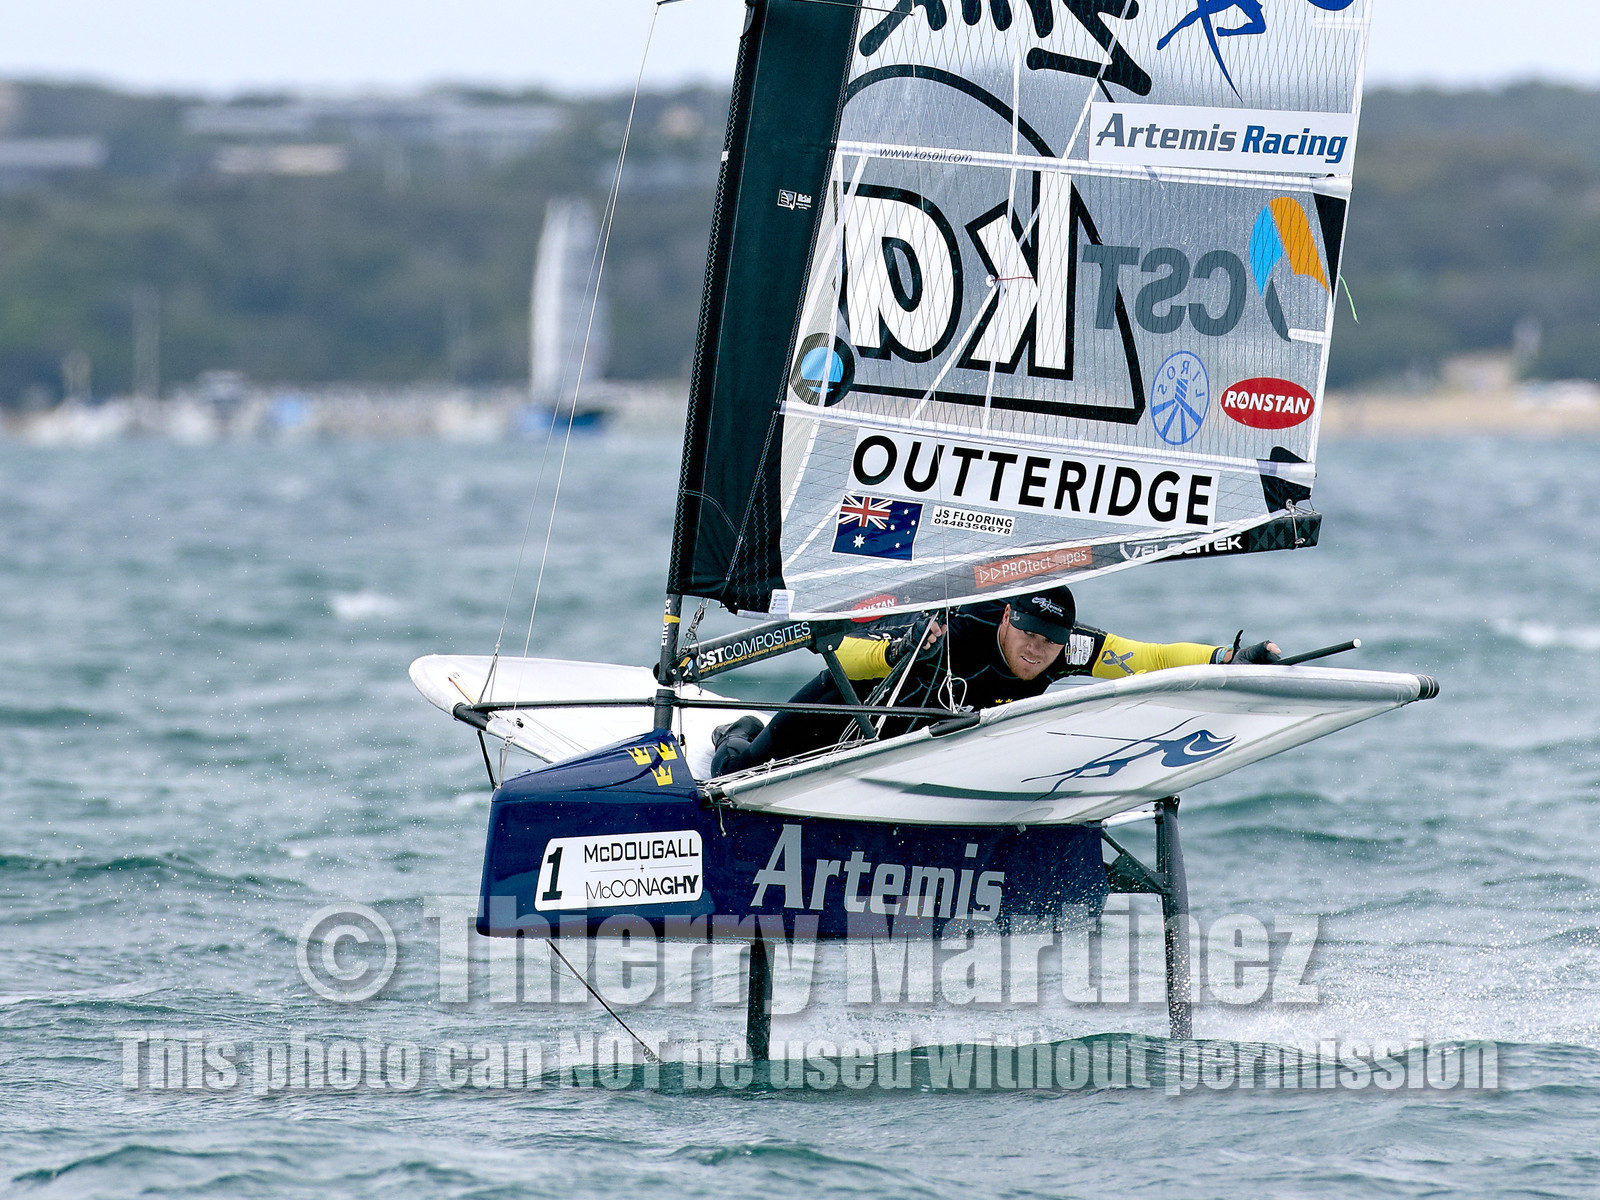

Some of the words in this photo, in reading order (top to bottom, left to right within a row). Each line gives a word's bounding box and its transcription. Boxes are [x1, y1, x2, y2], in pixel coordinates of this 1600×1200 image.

[1096, 112, 1237, 152] Artemis
[1241, 125, 1348, 164] Racing
[879, 147, 973, 163] www.kasail.com
[1224, 390, 1311, 416] RONSTAN
[852, 434, 1213, 527] OUTTERIDGE
[933, 518, 1012, 535] 0448356678
[935, 508, 950, 519] JS
[952, 511, 1014, 528] FLOORING
[1001, 556, 1051, 578] PROtect
[584, 838, 699, 863] McDOUGALL
[542, 847, 563, 901] 1
[750, 824, 1005, 921] Artemis
[585, 874, 699, 900] McCONAGHY
